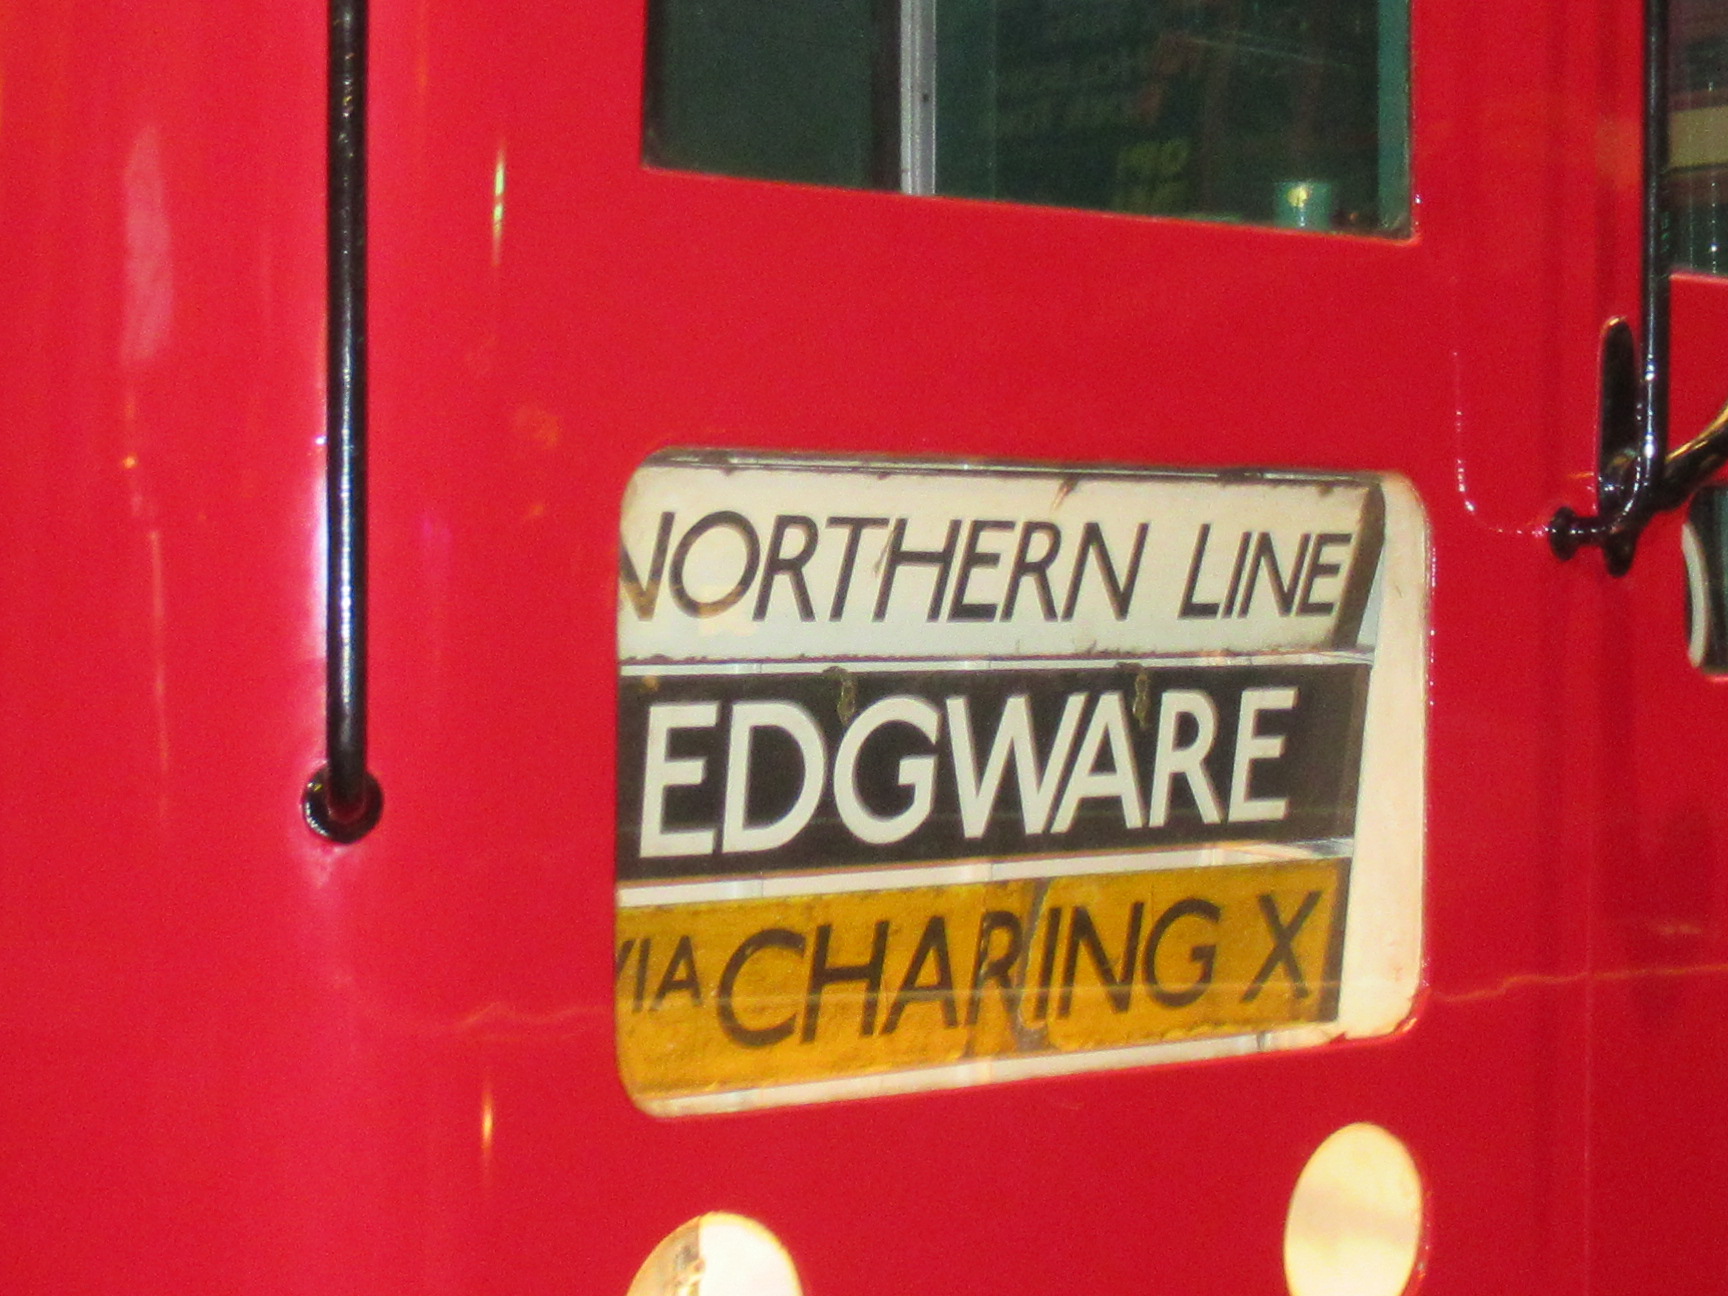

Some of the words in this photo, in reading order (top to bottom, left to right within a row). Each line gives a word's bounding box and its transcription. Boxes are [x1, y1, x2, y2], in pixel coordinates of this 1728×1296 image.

[614, 508, 1149, 625] NORTHERN
[1177, 522, 1351, 620] LINE
[638, 686, 1298, 858] EDGWARE
[716, 899, 1220, 1047] CHARING
[1240, 890, 1323, 1003] X
